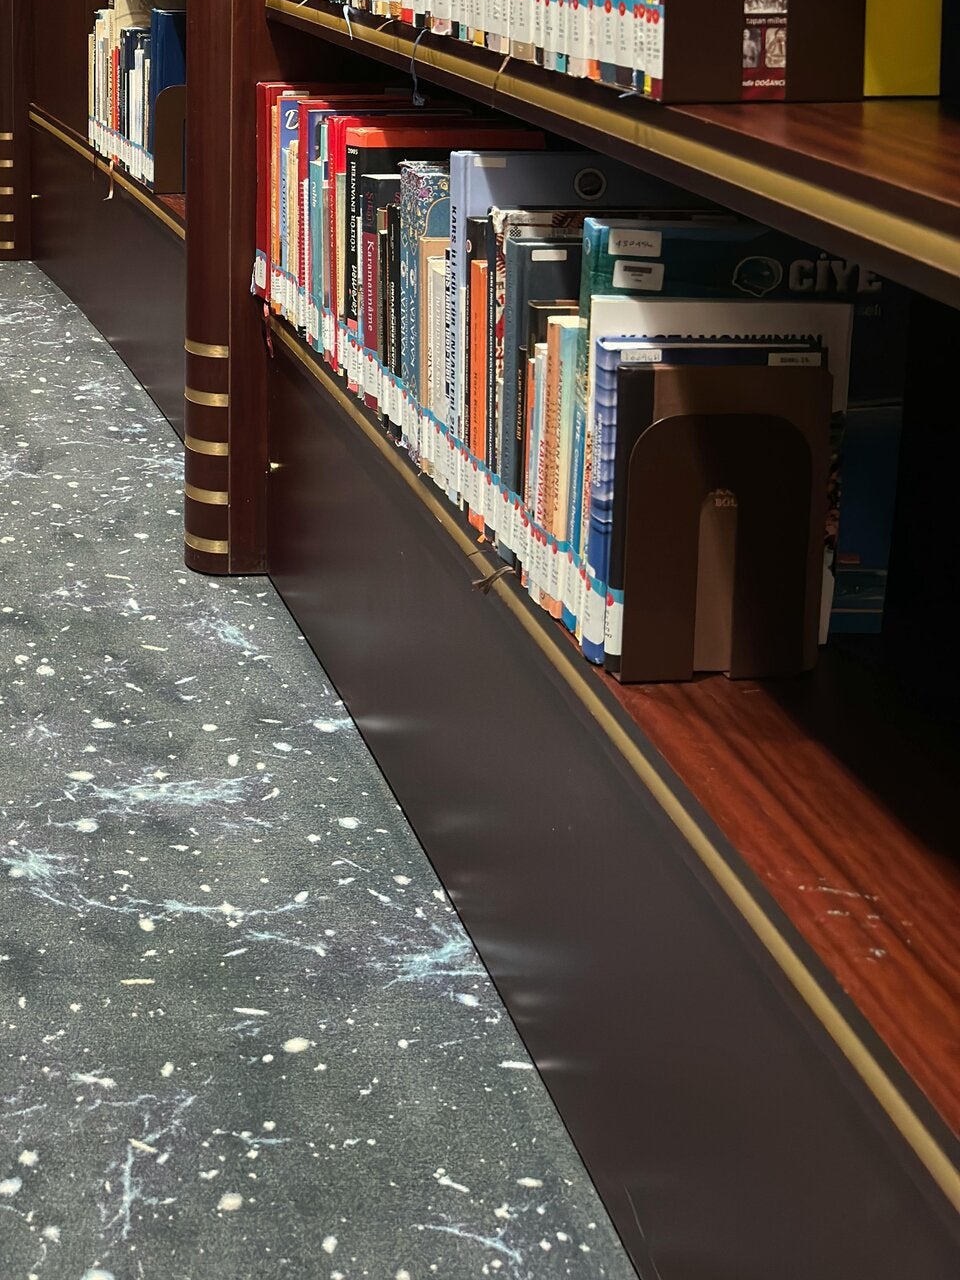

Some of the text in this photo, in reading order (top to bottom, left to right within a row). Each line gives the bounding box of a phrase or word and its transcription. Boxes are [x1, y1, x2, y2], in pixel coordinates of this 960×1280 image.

[349, 161, 357, 213] ENVANTERİ
[349, 215, 357, 253] KÜLTÜR
[450, 205, 458, 244] KARS
[366, 239, 376, 332] Karamannâme
[450, 271, 458, 327] KÜLTÜR
[789, 253, 883, 294] CİYE
[449, 331, 457, 411] ENVANTERİ
